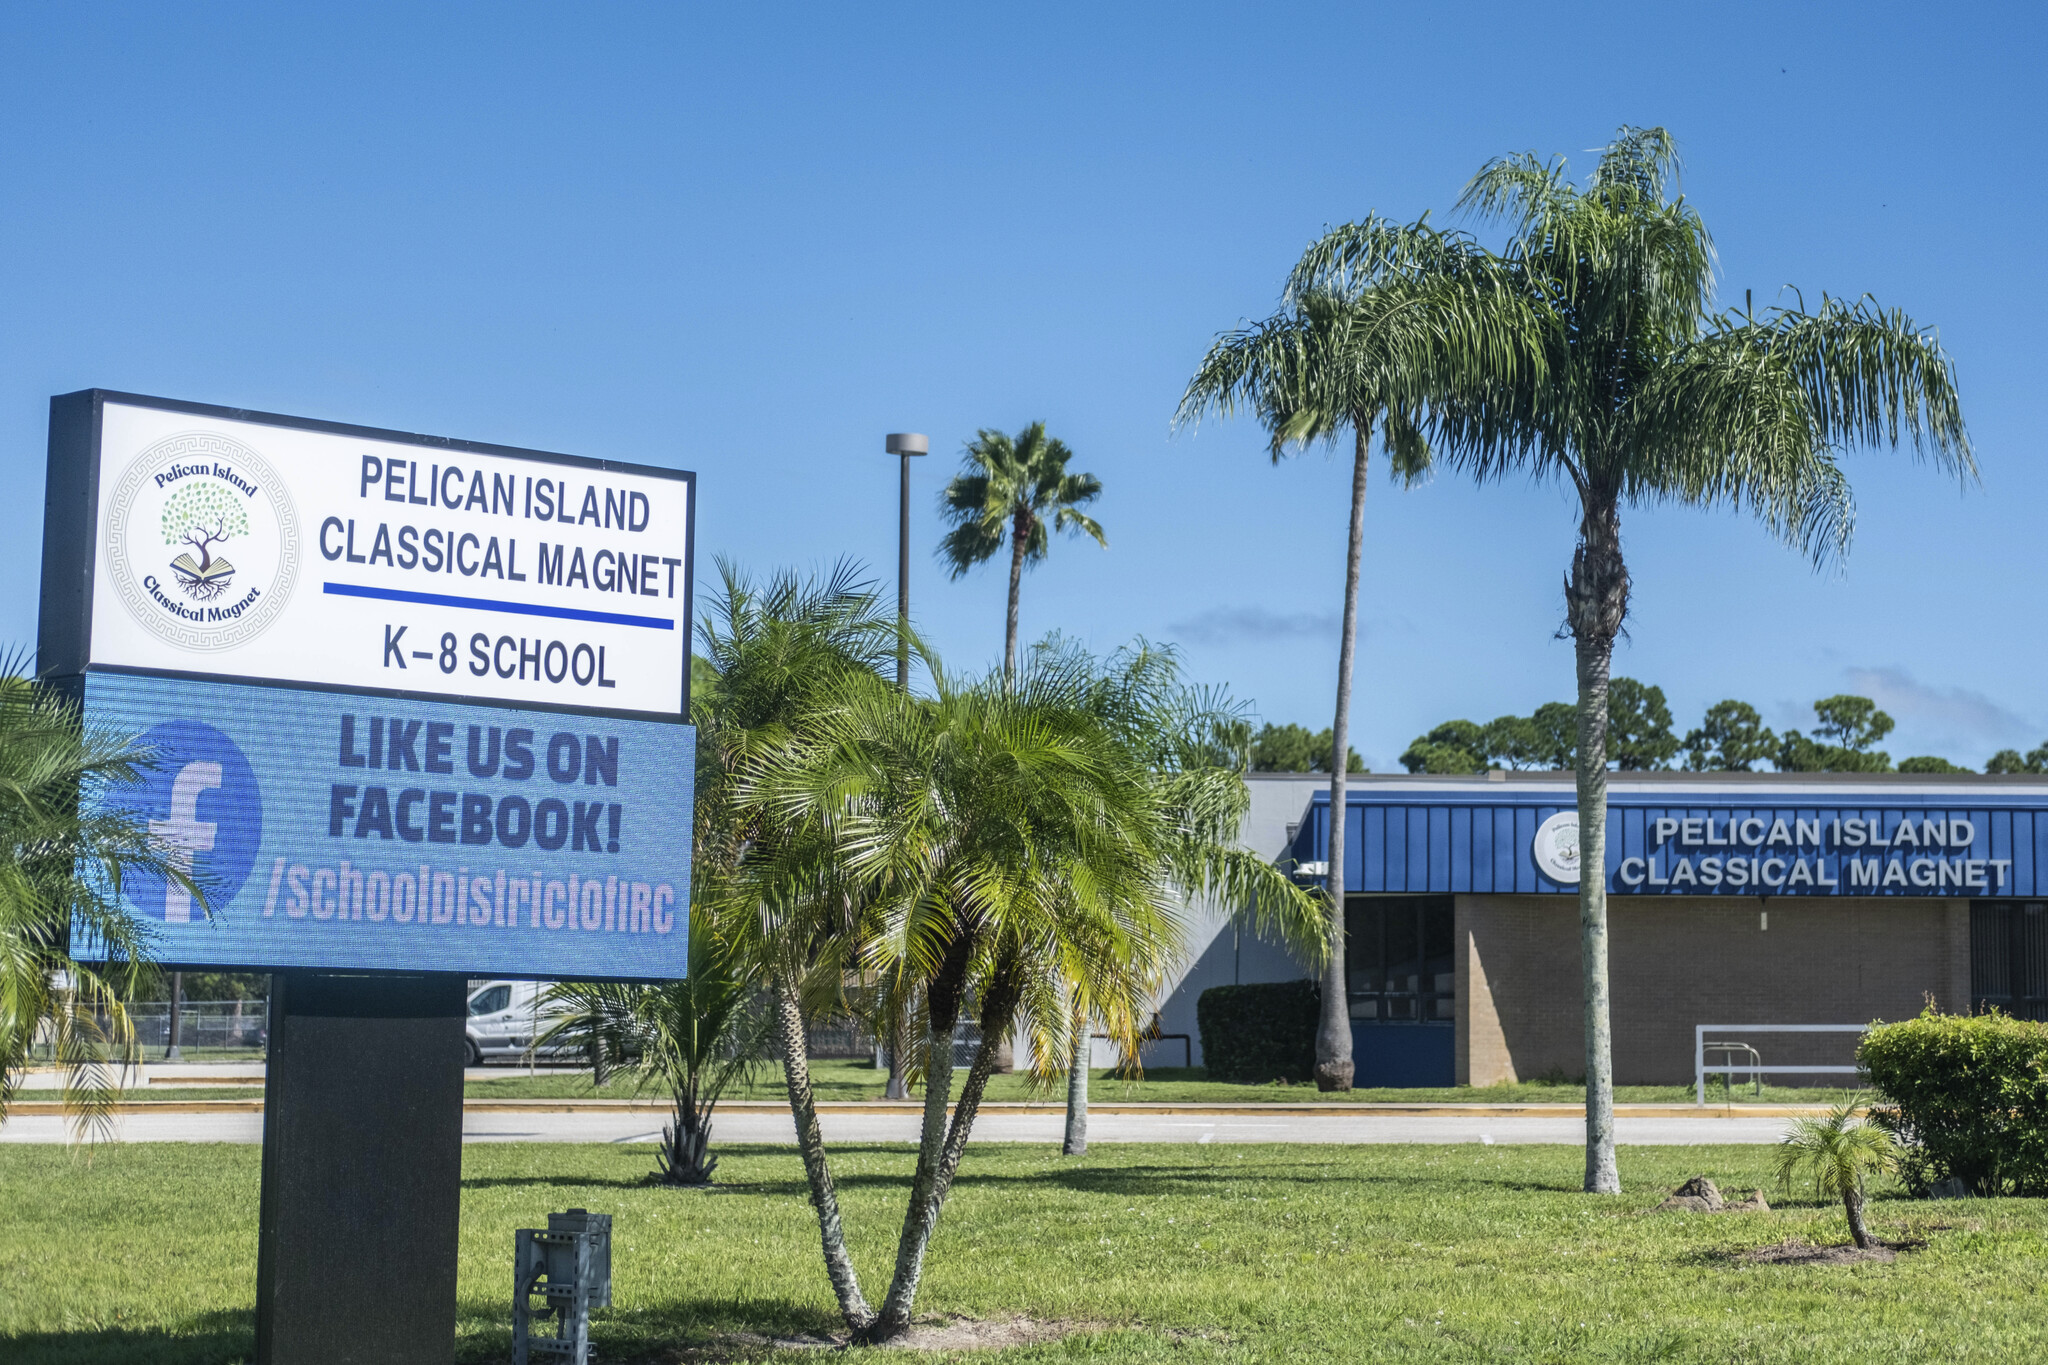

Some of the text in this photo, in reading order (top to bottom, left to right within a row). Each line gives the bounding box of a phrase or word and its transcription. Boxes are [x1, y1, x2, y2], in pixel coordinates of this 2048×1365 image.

[154, 462, 258, 498] Pelican Island
[360, 455, 650, 532] PELICAN ISLAND
[320, 516, 682, 599] CLASSICAL MAGNET
[143, 575, 261, 623] Classical Magnet
[469, 632, 616, 688] SCHOOL
[339, 713, 619, 787] LIKE US ON
[329, 783, 622, 854] FACEBOOK!
[1656, 818, 1975, 848] PELICAN ISLAND
[1620, 857, 2012, 887] CLASSICAL MAGNET
